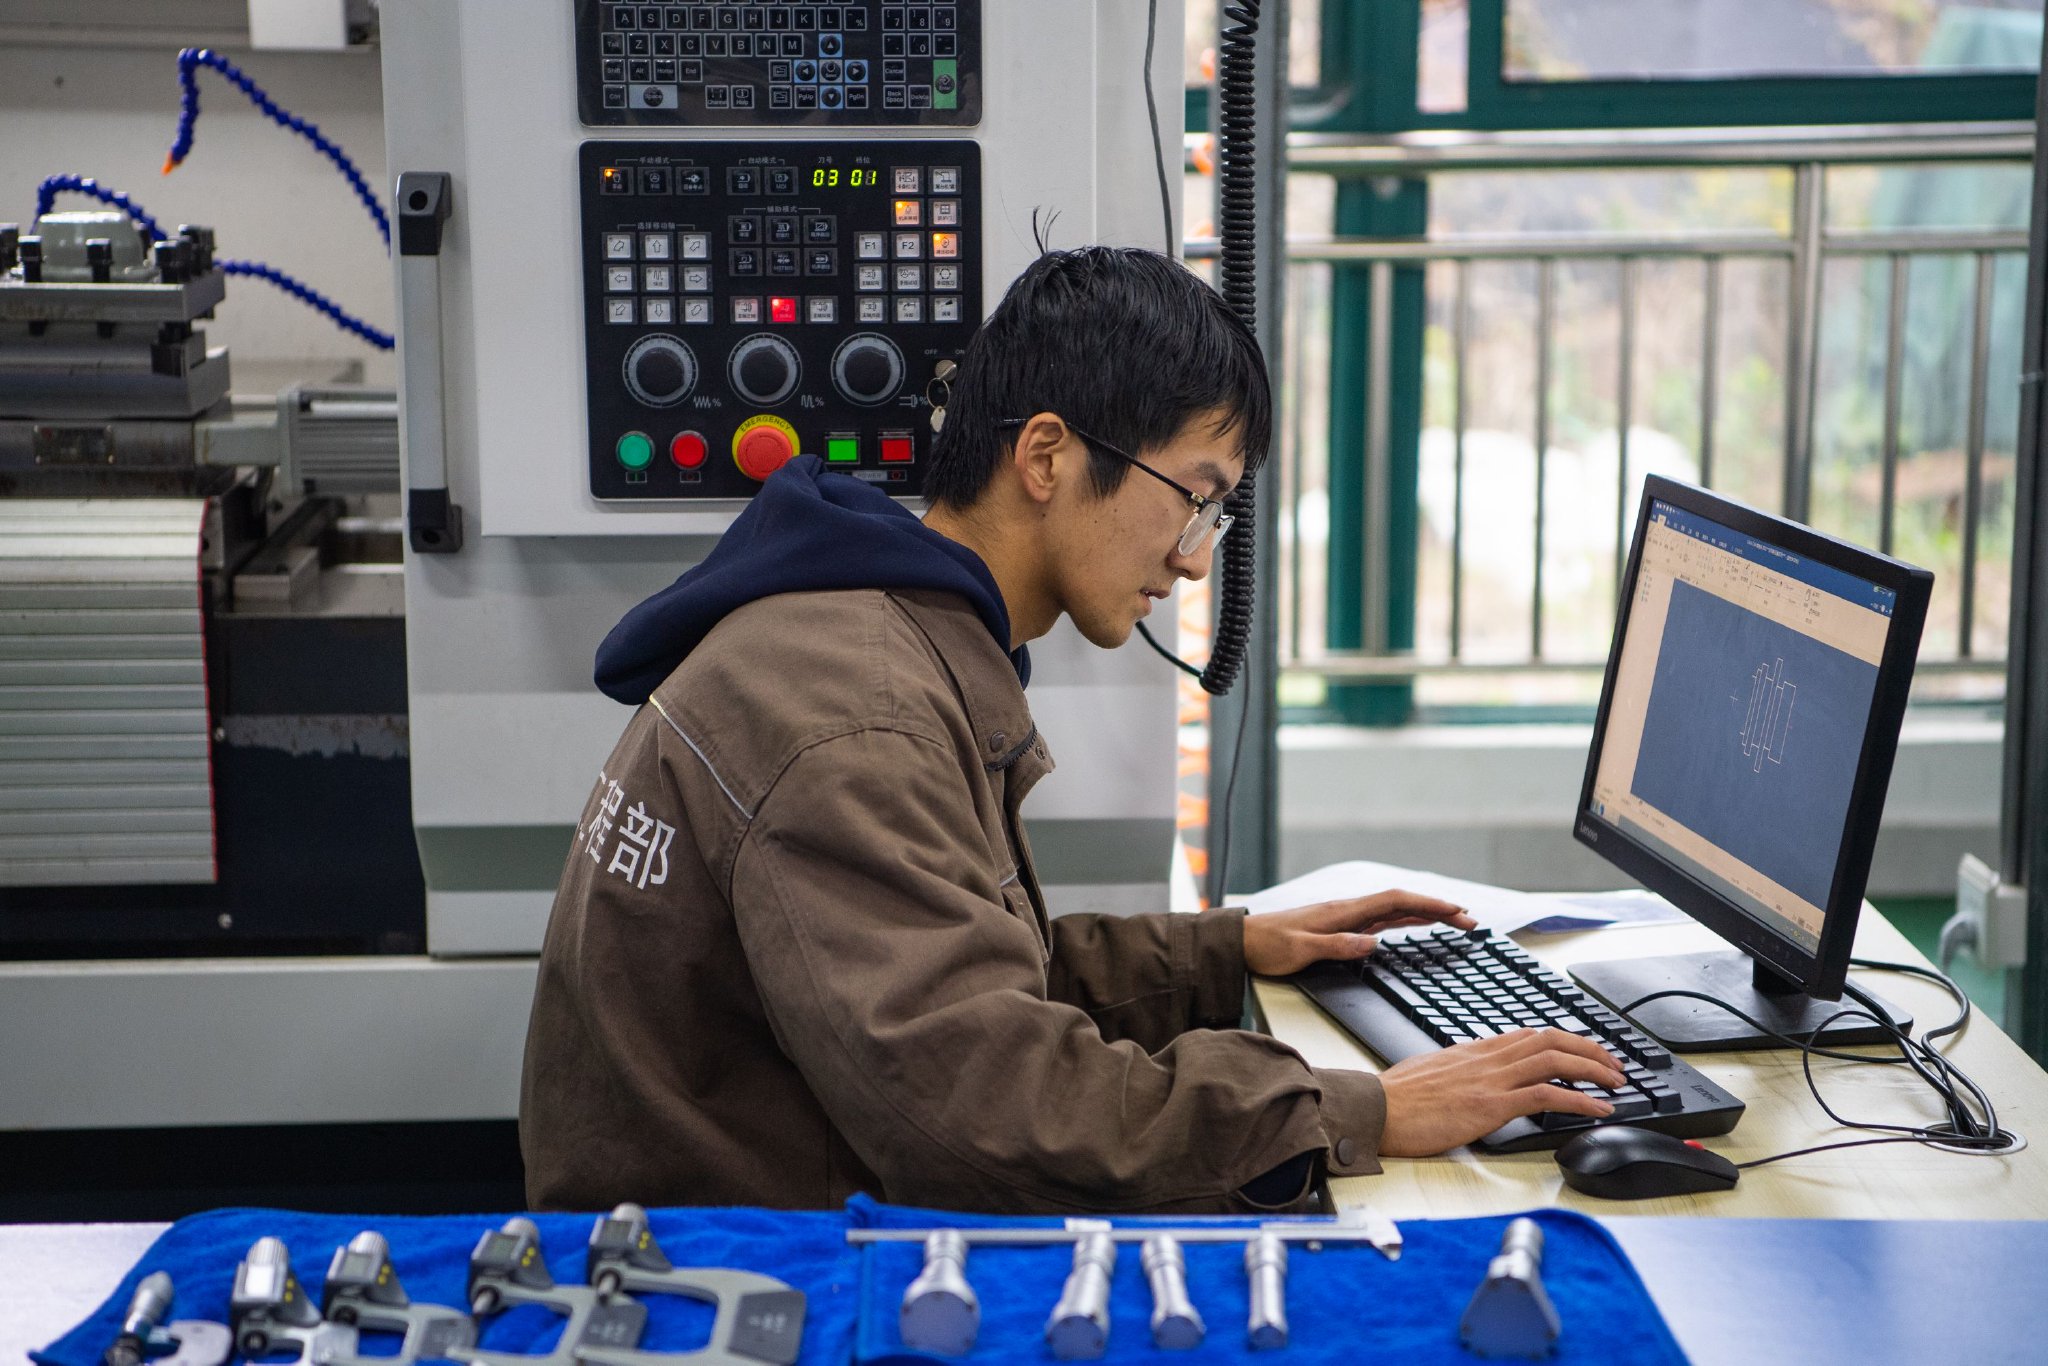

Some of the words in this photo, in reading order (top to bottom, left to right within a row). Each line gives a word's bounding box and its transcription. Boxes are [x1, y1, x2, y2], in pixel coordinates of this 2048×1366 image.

[621, 13, 629, 23] A
[647, 13, 655, 23] S
[672, 13, 680, 23] D
[698, 14, 705, 23] F
[723, 14, 732, 23] G
[749, 14, 757, 23] H
[776, 14, 782, 23] J
[800, 14, 808, 23] K
[826, 14, 833, 23] L
[635, 40, 643, 49] Z
[661, 40, 668, 49] X
[686, 40, 694, 50] C
[711, 40, 719, 49] V
[737, 40, 745, 50] B
[762, 40, 771, 50] N
[787, 40, 797, 50] M
[645, 93, 663, 101] Space
[798, 93, 814, 101] PgUp
[818, 156, 833, 164] 刀号
[812, 169, 839, 187] 03
[850, 169, 877, 187] 01
[864, 241, 876, 250] F1
[902, 241, 915, 250] F2
[739, 415, 792, 432] EMERGENCY
[578, 770, 677, 890] 程部
[1579, 821, 1598, 842] Lenovo
[1691, 1084, 1721, 1104] Lenovo
